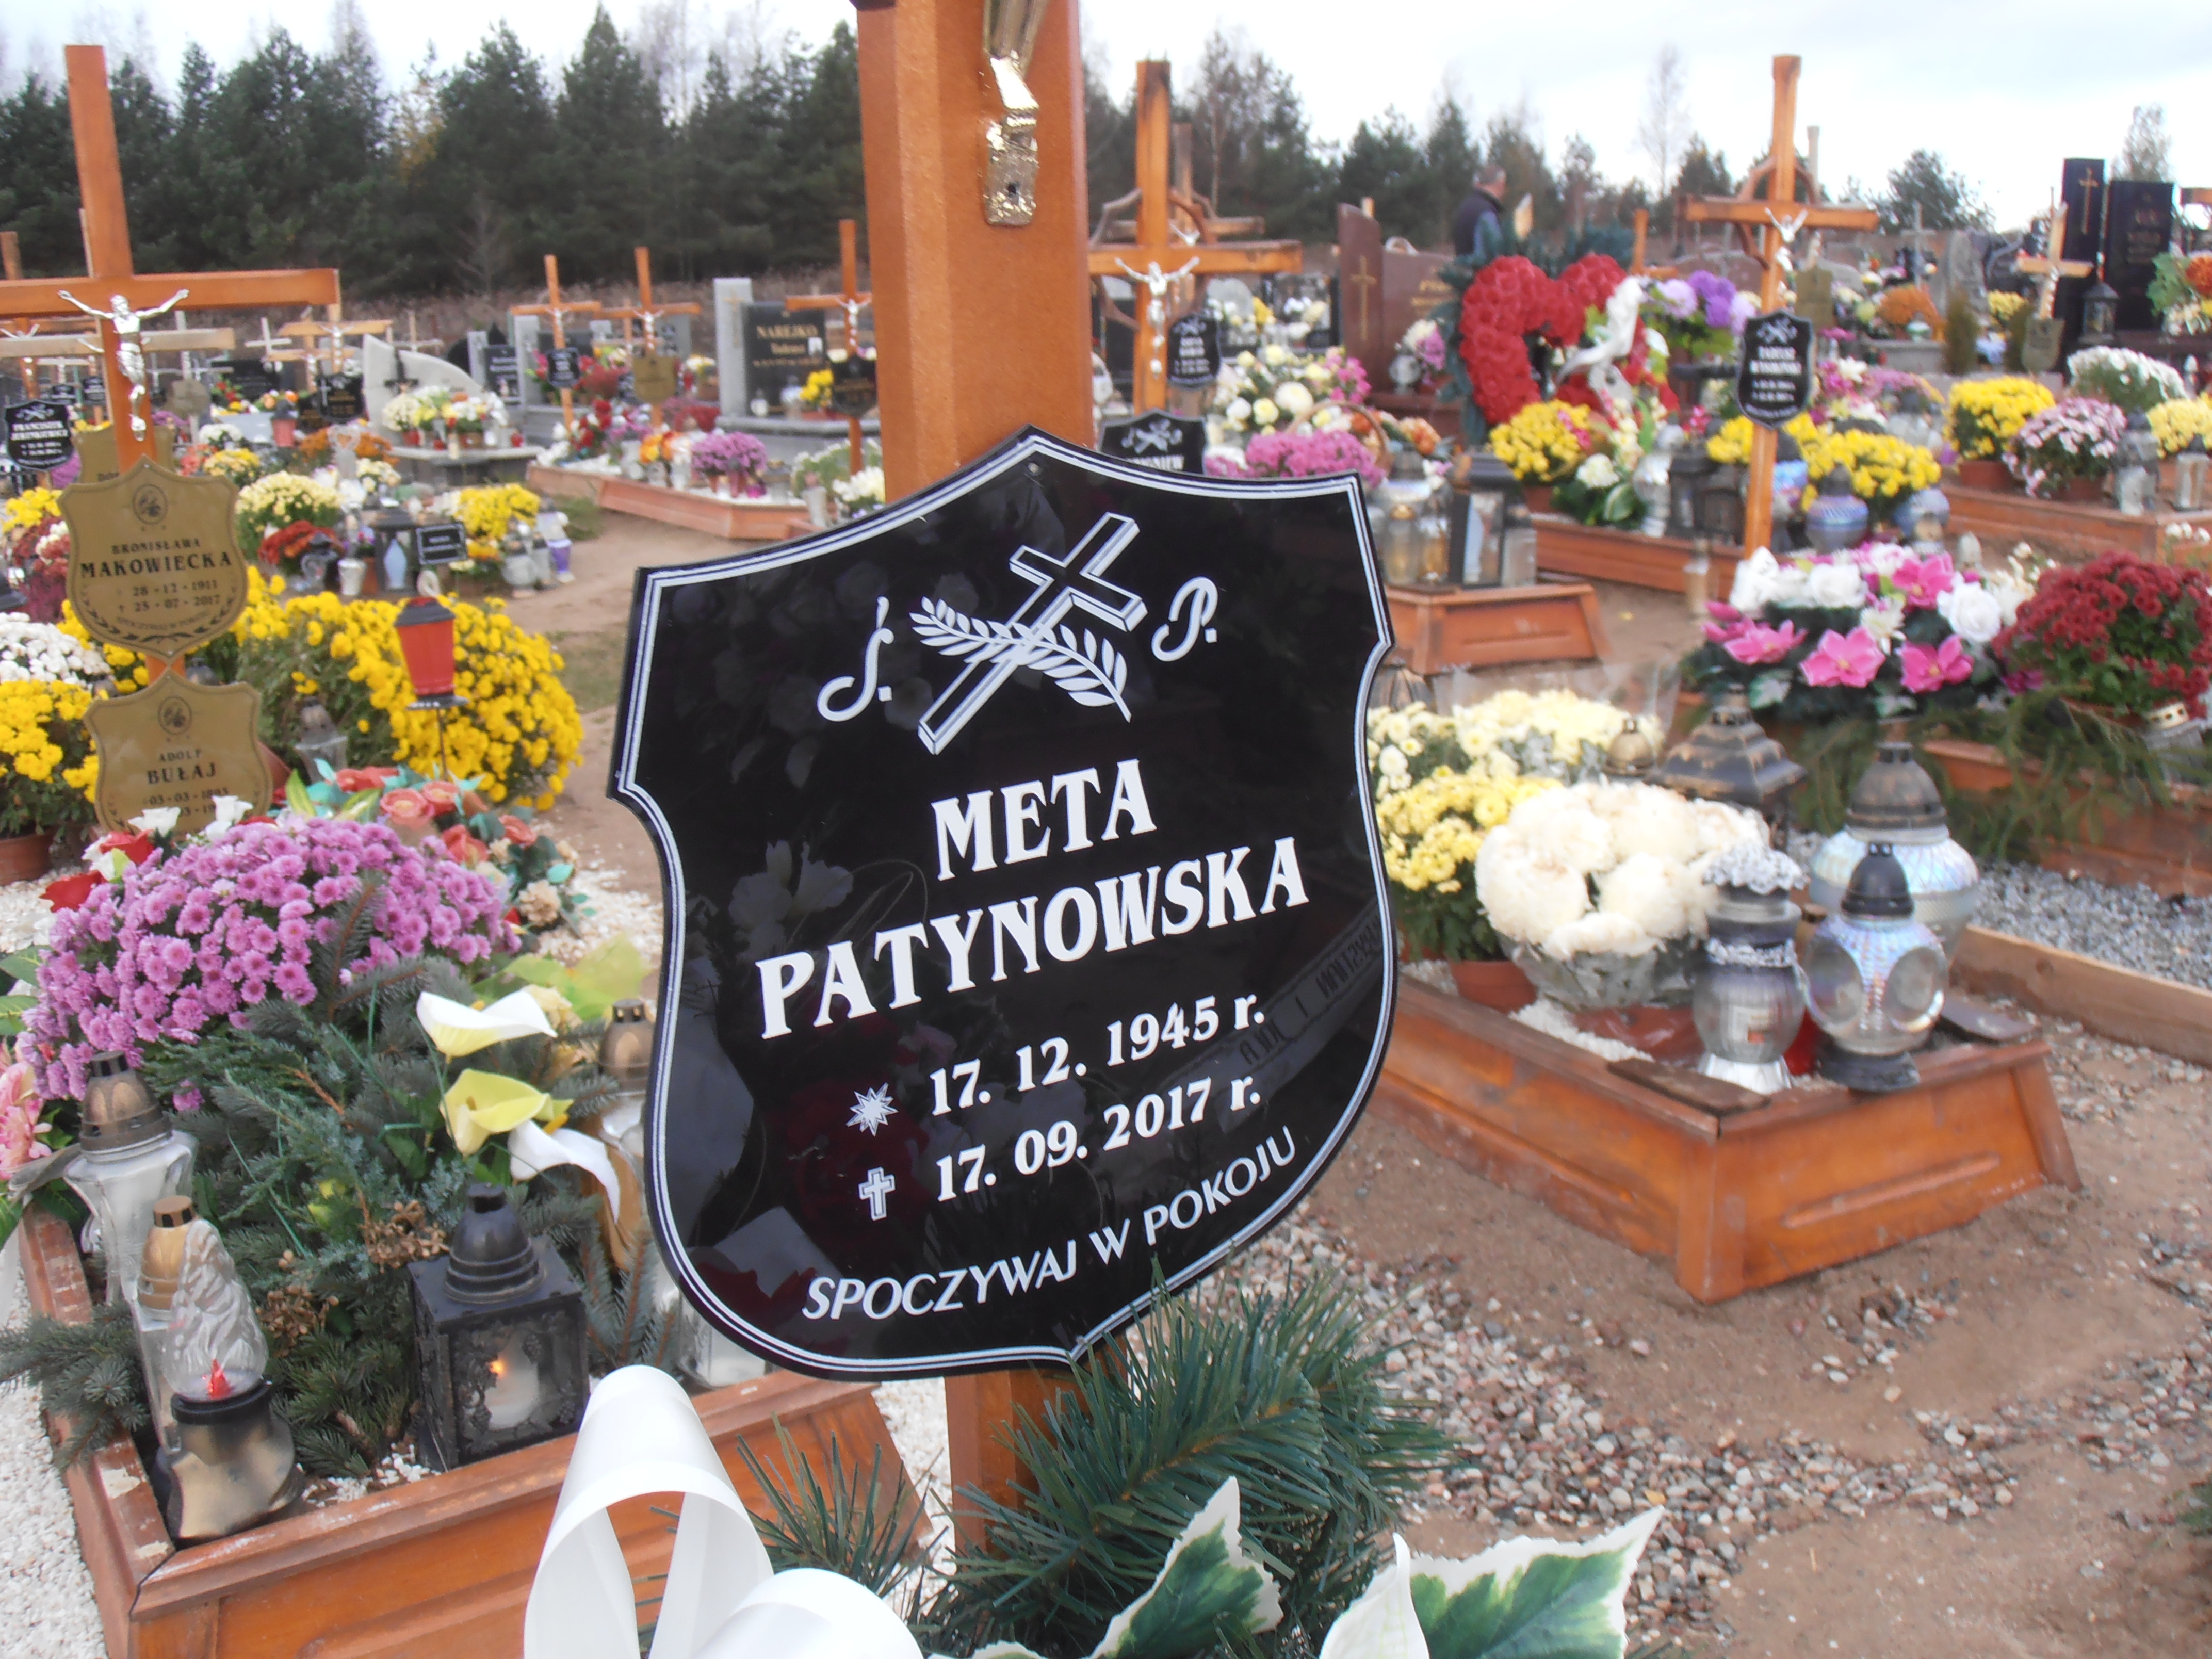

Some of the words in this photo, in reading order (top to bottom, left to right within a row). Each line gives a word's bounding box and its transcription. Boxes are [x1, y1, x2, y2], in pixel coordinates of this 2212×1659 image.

[80, 551, 231, 578] MAKOWIECKA
[147, 762, 216, 785] BUŁAJ
[931, 759, 1157, 881] META
[755, 837, 1309, 1039] PATYNOWSKA
[930, 1059, 990, 1115] 17.
[1016, 1037, 1086, 1091] 12.
[1108, 996, 1218, 1066] 1945
[1234, 995, 1264, 1030] r.
[937, 1144, 996, 1201] 17.
[1015, 1121, 1087, 1174] 09.
[1103, 1077, 1211, 1151] 2017
[1230, 1076, 1260, 1111] r.
[802, 1240, 1076, 1319] SPOCZYWAJ
[1089, 1219, 1130, 1264] W
[1144, 1126, 1295, 1245] POKOJU
